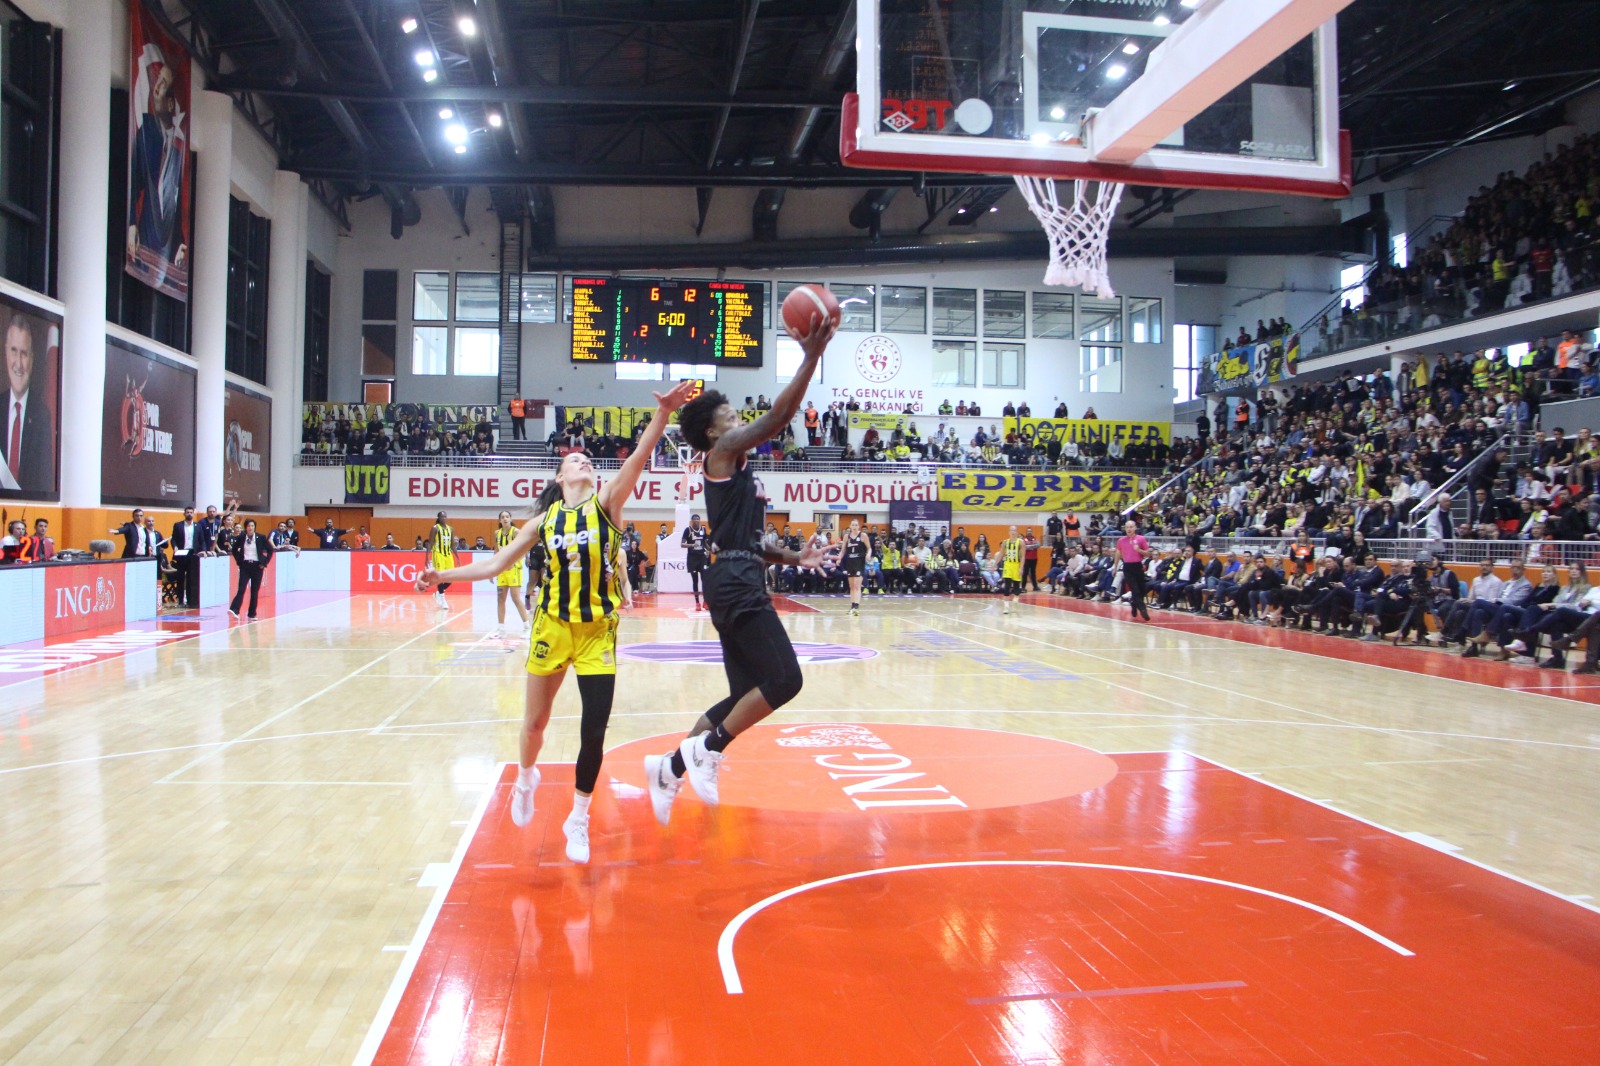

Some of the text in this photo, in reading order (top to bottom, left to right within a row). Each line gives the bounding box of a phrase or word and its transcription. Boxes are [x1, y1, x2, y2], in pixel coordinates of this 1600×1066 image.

[651, 287, 660, 301] 6
[684, 288, 697, 302] 12
[658, 312, 685, 326] 6:00
[640, 325, 649, 337] 2
[667, 326, 672, 337] 1
[690, 326, 696, 338] 1
[856, 388, 905, 400] GENÇLİK
[909, 390, 923, 399] VE
[345, 465, 388, 494] UTG
[941, 471, 1133, 493] EDİRNE
[408, 473, 499, 498] EDİRNE
[784, 479, 938, 503] MÜDÜRLÜĞÜ
[962, 495, 1047, 507] G.F.B
[548, 528, 599, 550] opet
[566, 551, 583, 572] 2
[663, 562, 685, 571] ING
[366, 563, 417, 582] ING
[55, 585, 91, 618] ING
[811, 752, 969, 811] ING
